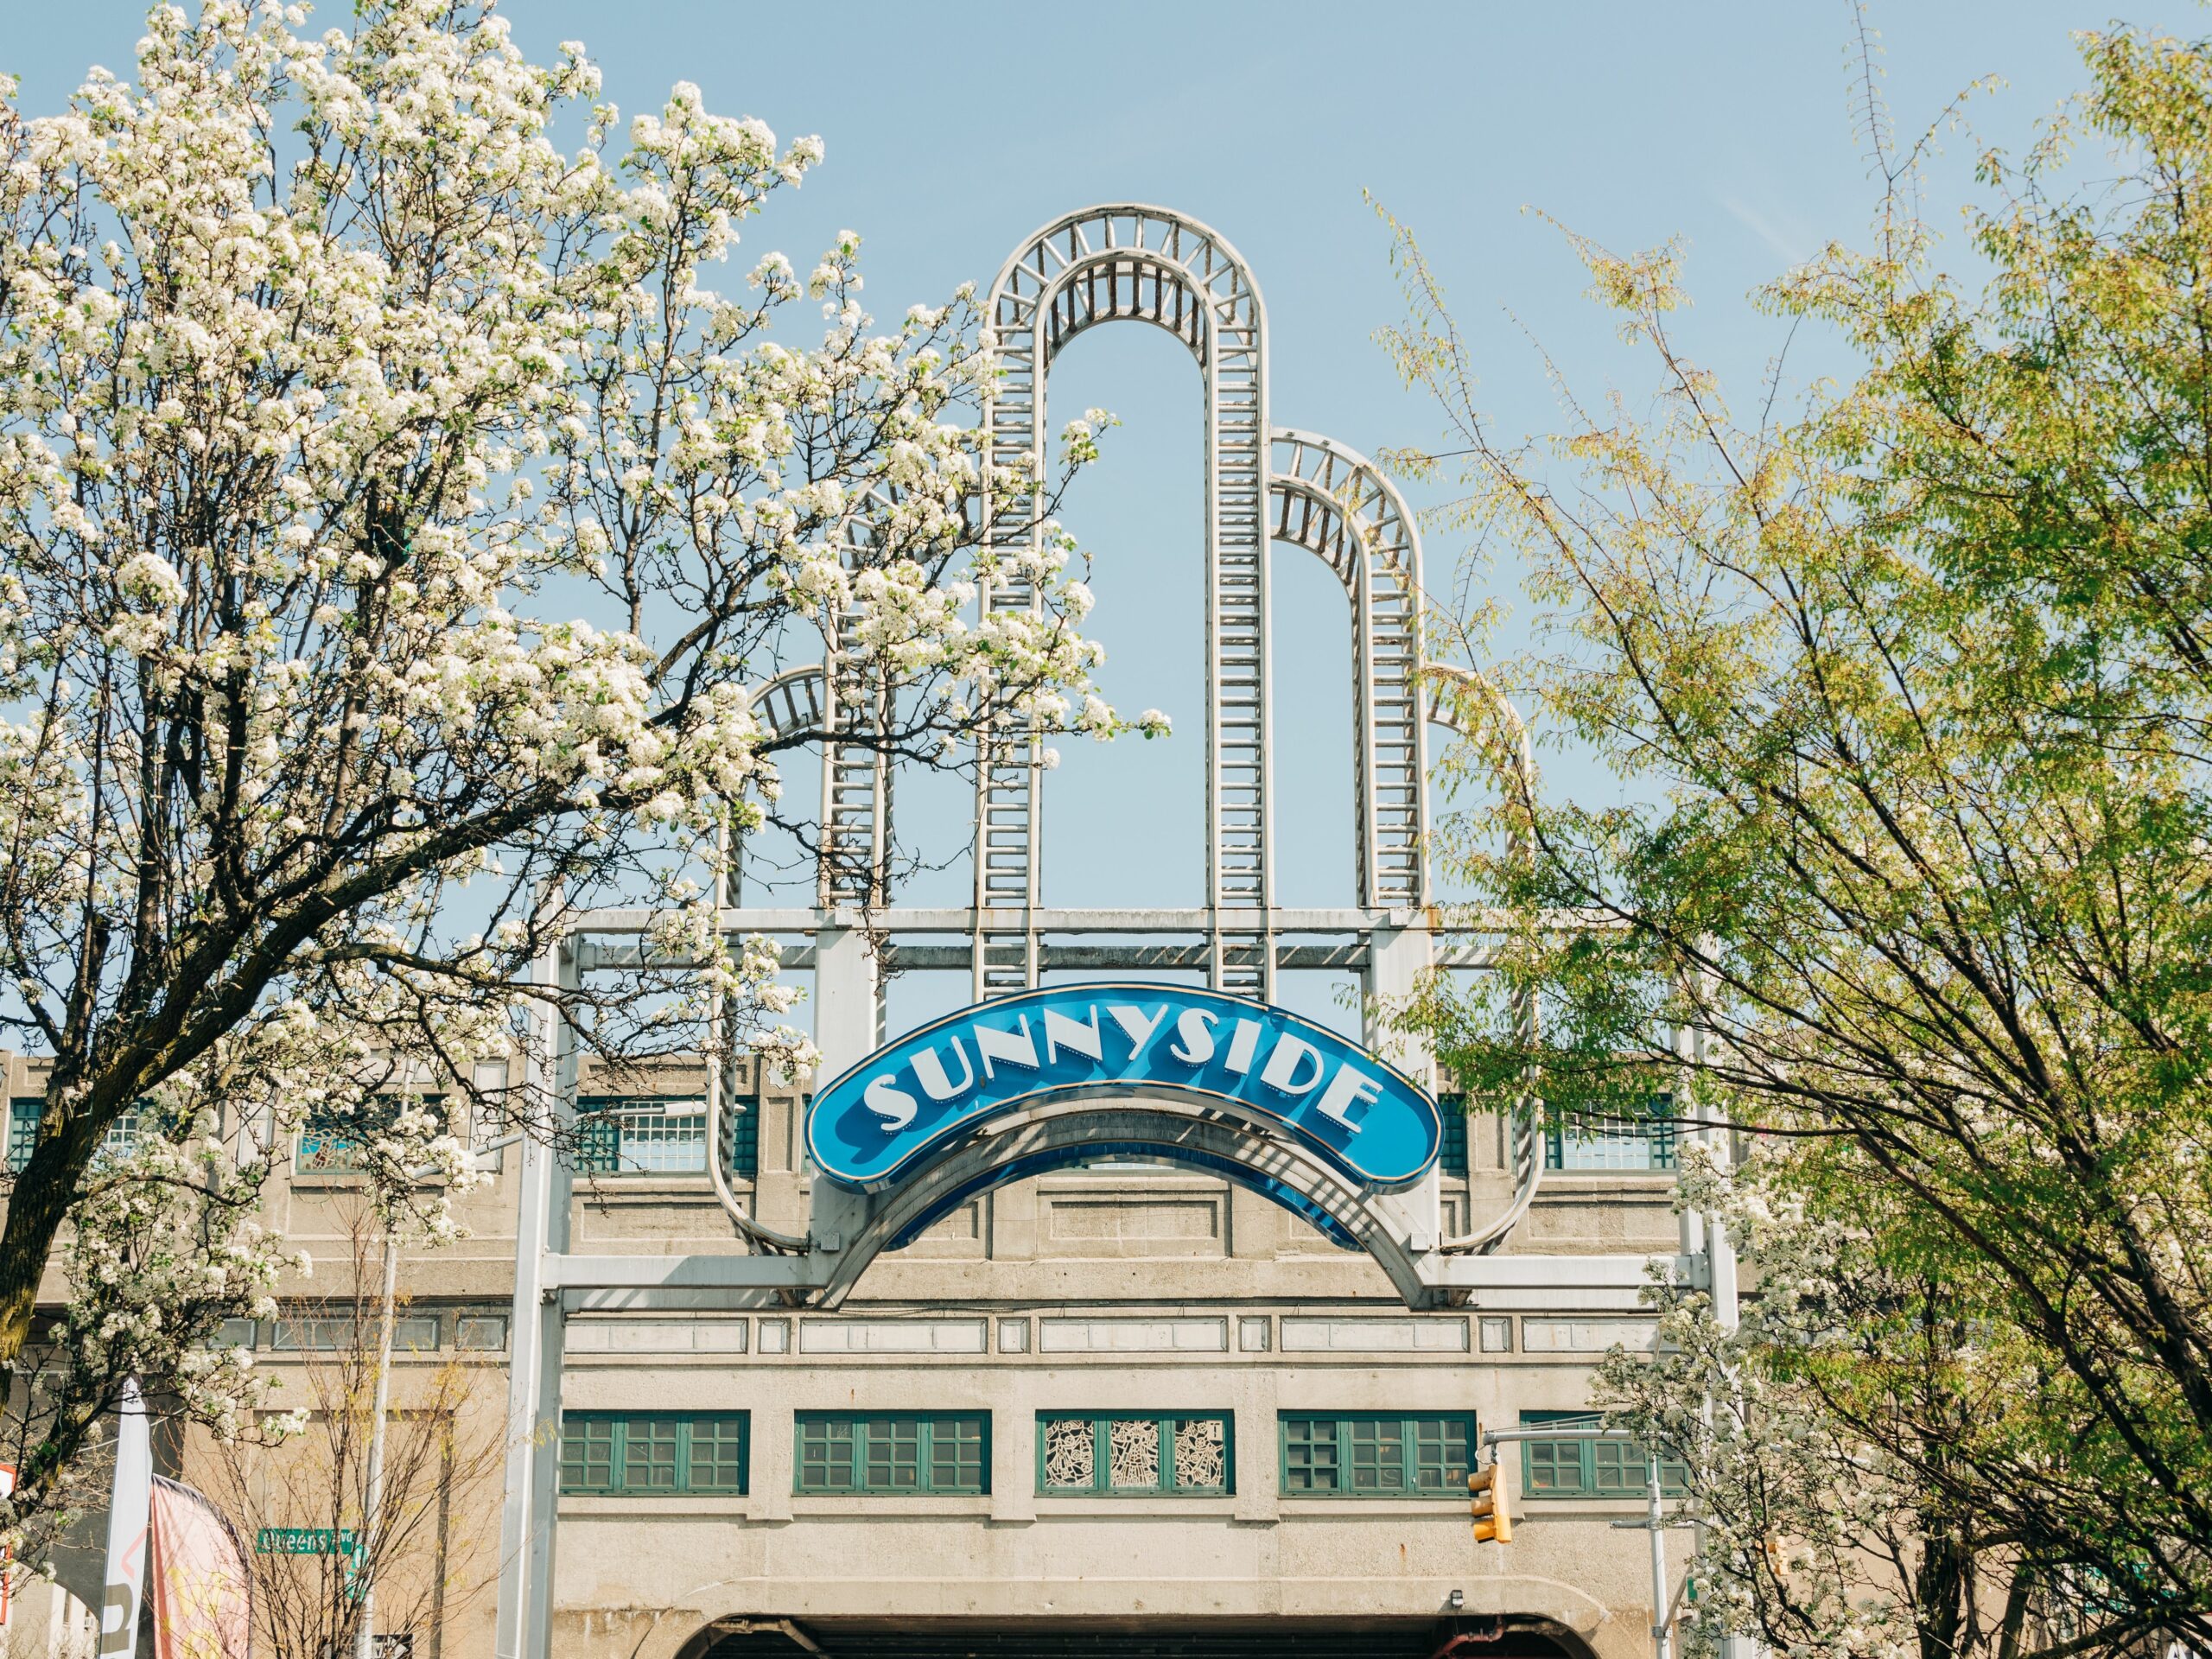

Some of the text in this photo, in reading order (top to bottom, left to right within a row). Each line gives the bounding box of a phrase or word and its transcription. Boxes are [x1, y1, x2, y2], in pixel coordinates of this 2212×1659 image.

[863, 1003, 1382, 1136] SUNNYSIDE
[263, 1530, 353, 1551] Queens Bvd
